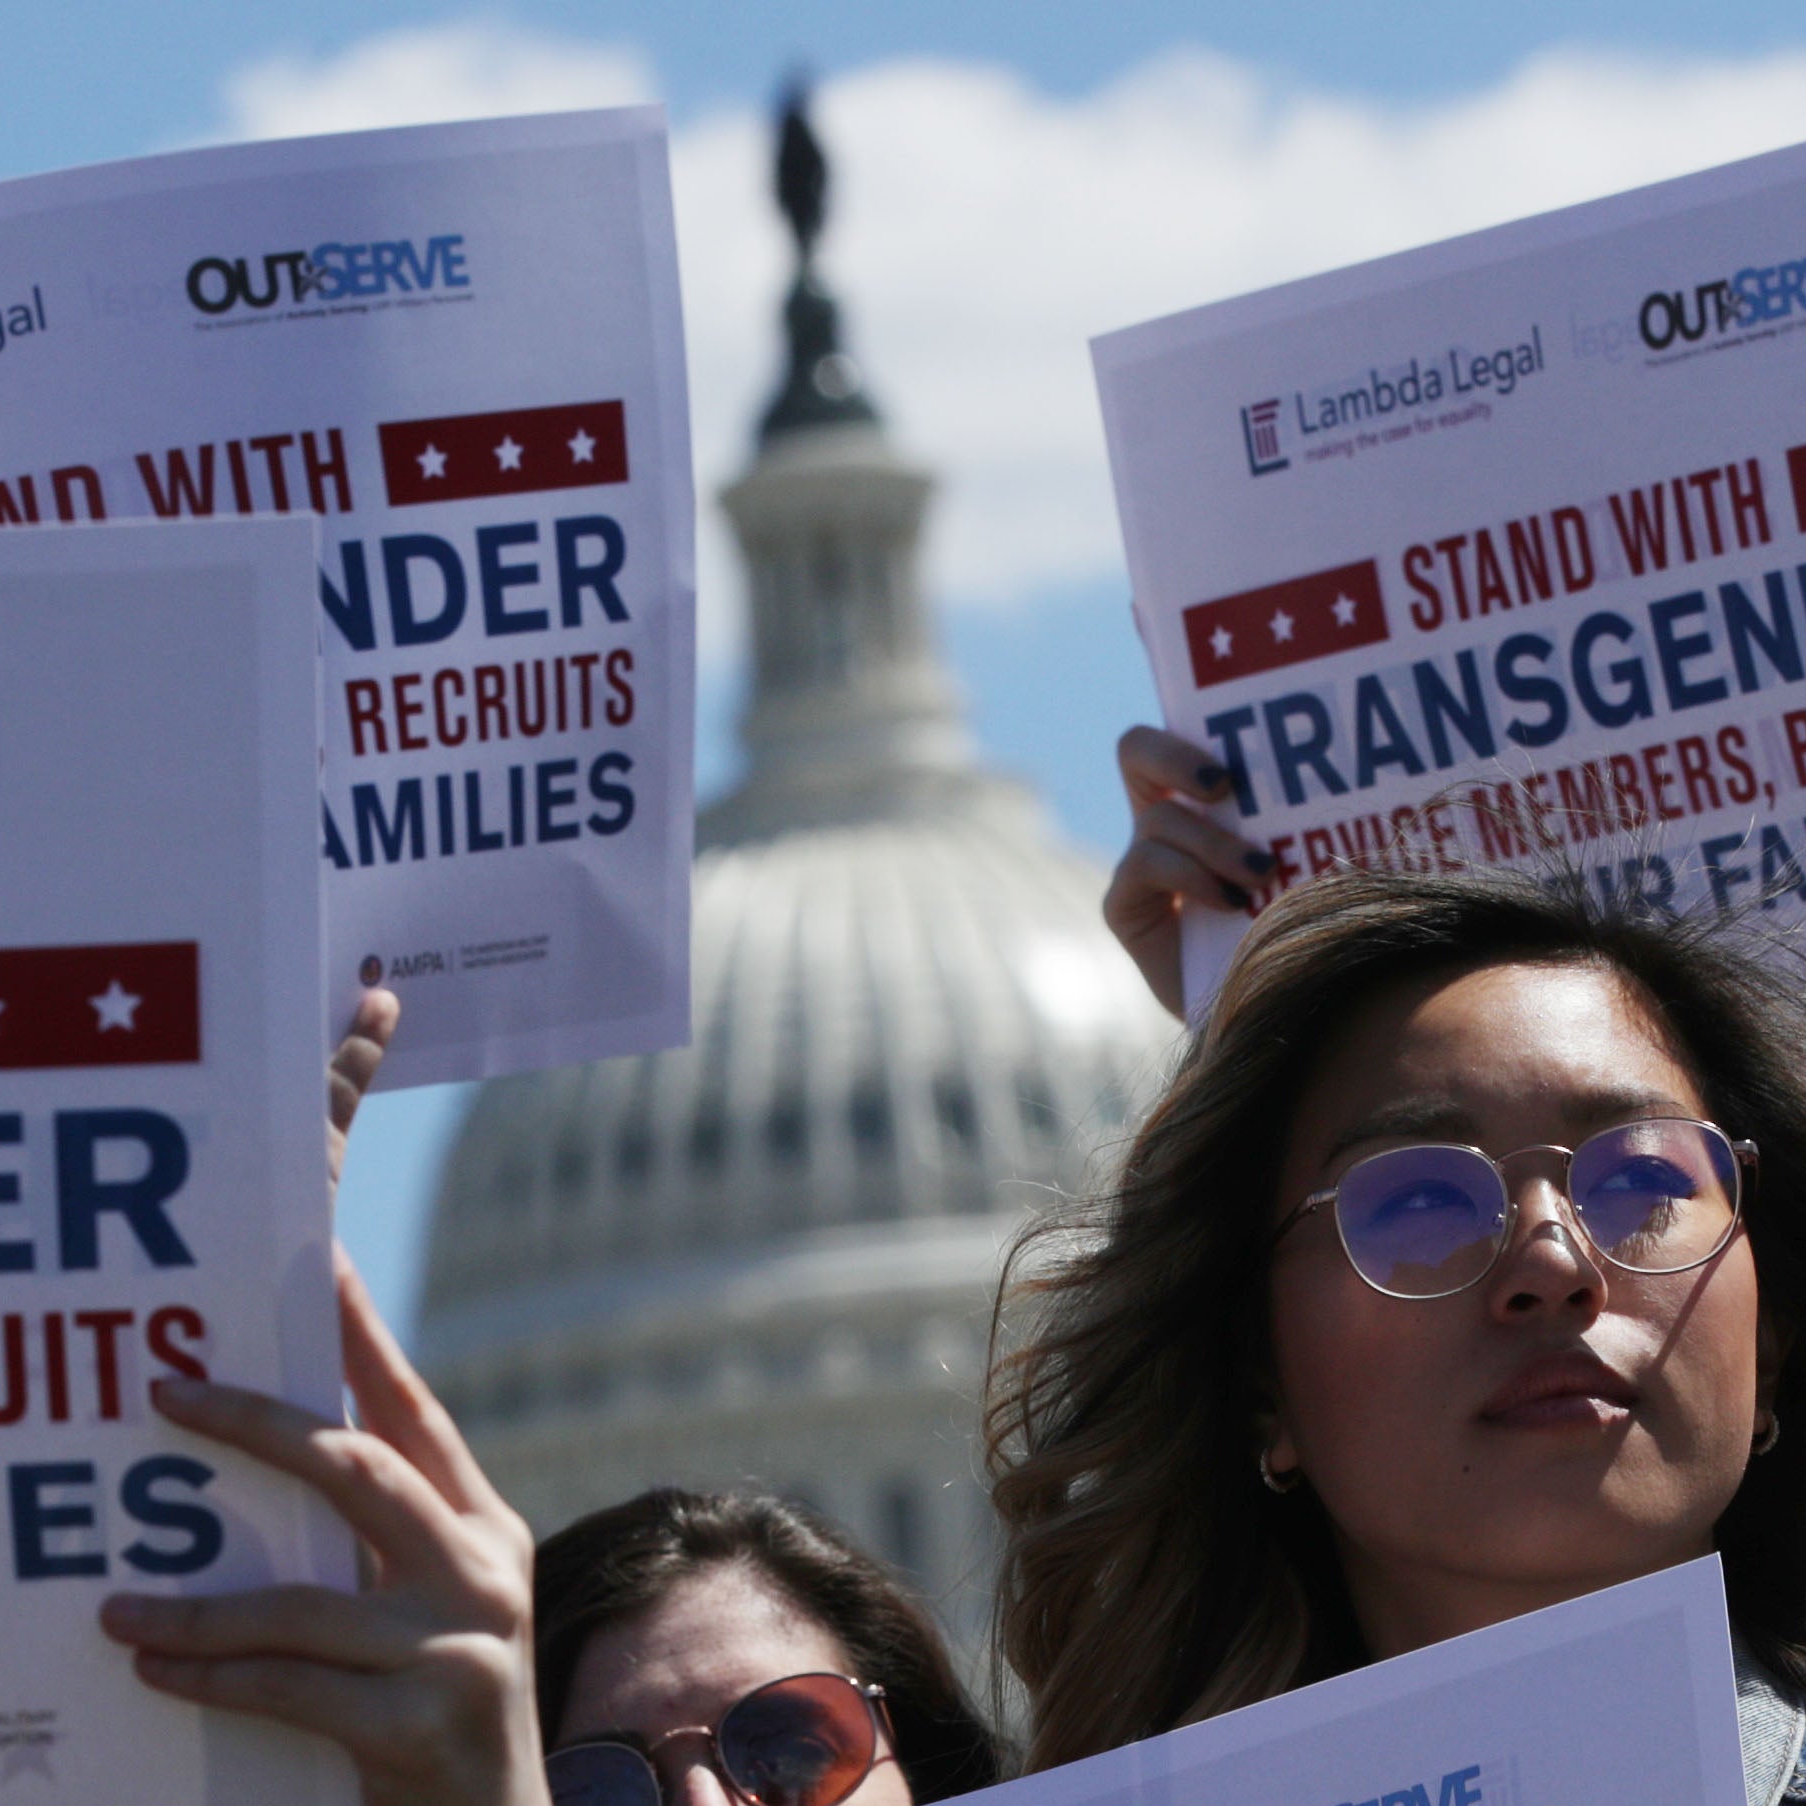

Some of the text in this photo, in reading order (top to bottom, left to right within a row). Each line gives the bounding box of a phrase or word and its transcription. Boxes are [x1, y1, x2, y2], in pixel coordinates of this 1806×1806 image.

[1296, 324, 1545, 435] Lambda Legal
[135, 427, 353, 518] WITH
[1402, 457, 1772, 633] STAND WITH
[345, 648, 635, 757] RECRUITS
[321, 750, 636, 870] MILIES
[1246, 799, 1465, 917] ERVICE
